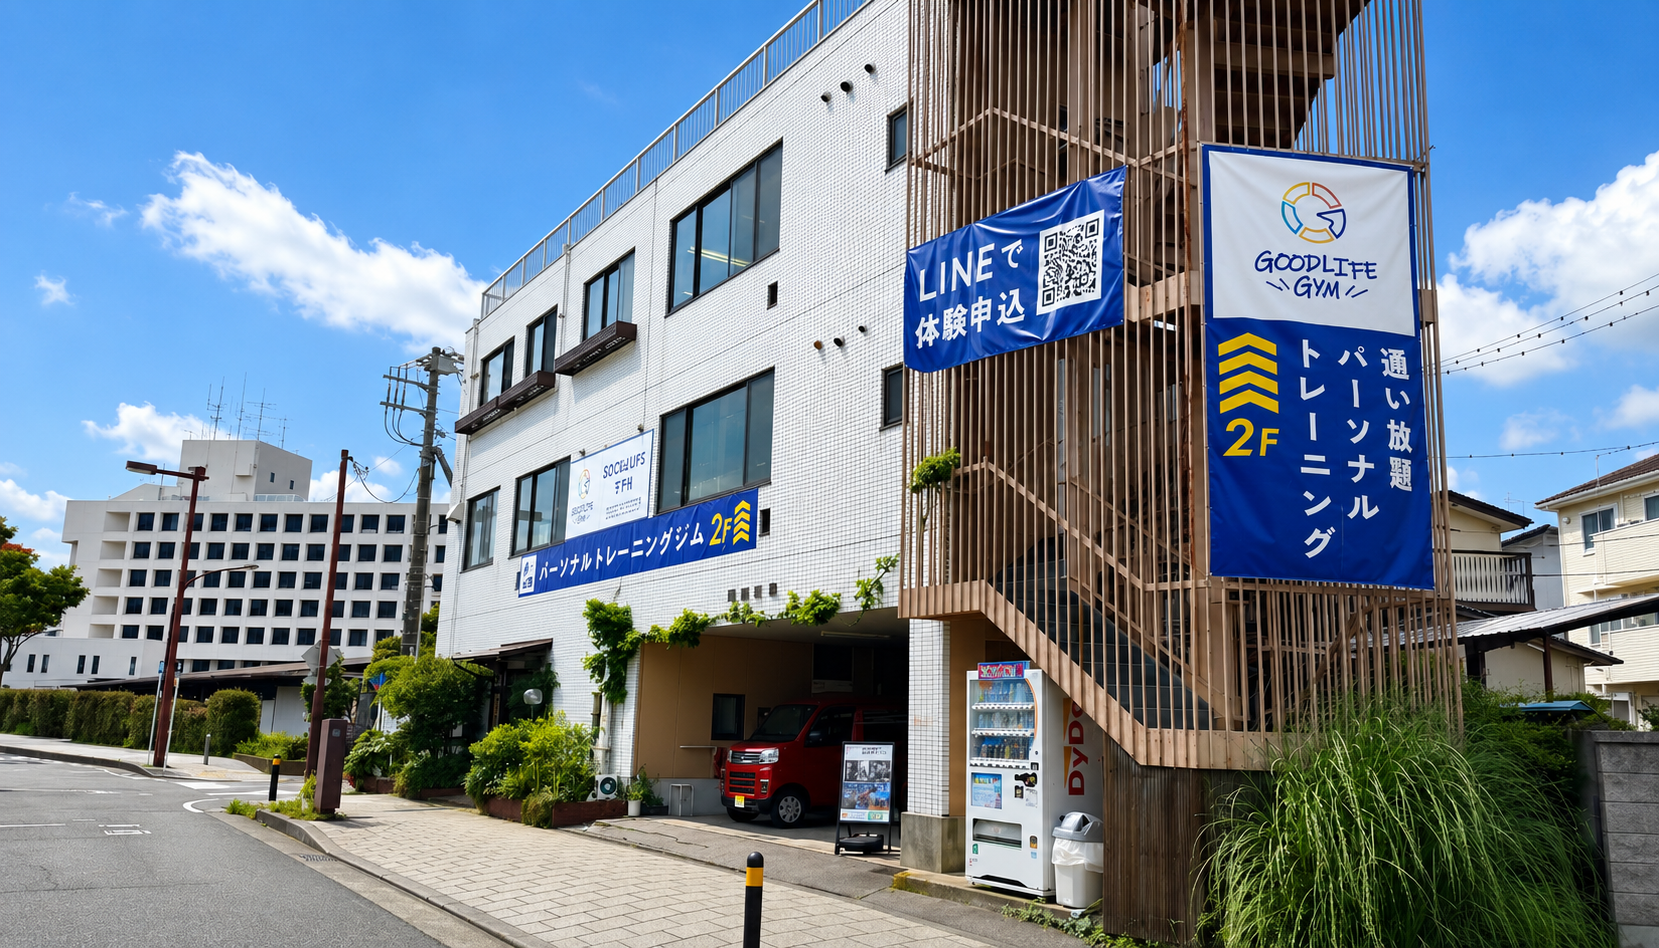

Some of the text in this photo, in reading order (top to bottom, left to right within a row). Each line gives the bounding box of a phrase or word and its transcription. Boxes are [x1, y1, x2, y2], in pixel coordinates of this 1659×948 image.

[919, 239, 1024, 302] LINEで
[1254, 250, 1378, 280] GOODLIFE
[1294, 275, 1340, 299] GYM
[915, 288, 1026, 350] 体験申込
[1222, 418, 1280, 457] 2F
[1299, 339, 1336, 559] トレーニング
[1338, 345, 1380, 520] パーソナル
[1380, 347, 1413, 492] 通い放題
[538, 522, 704, 581] パーソナルトレーニングジム
